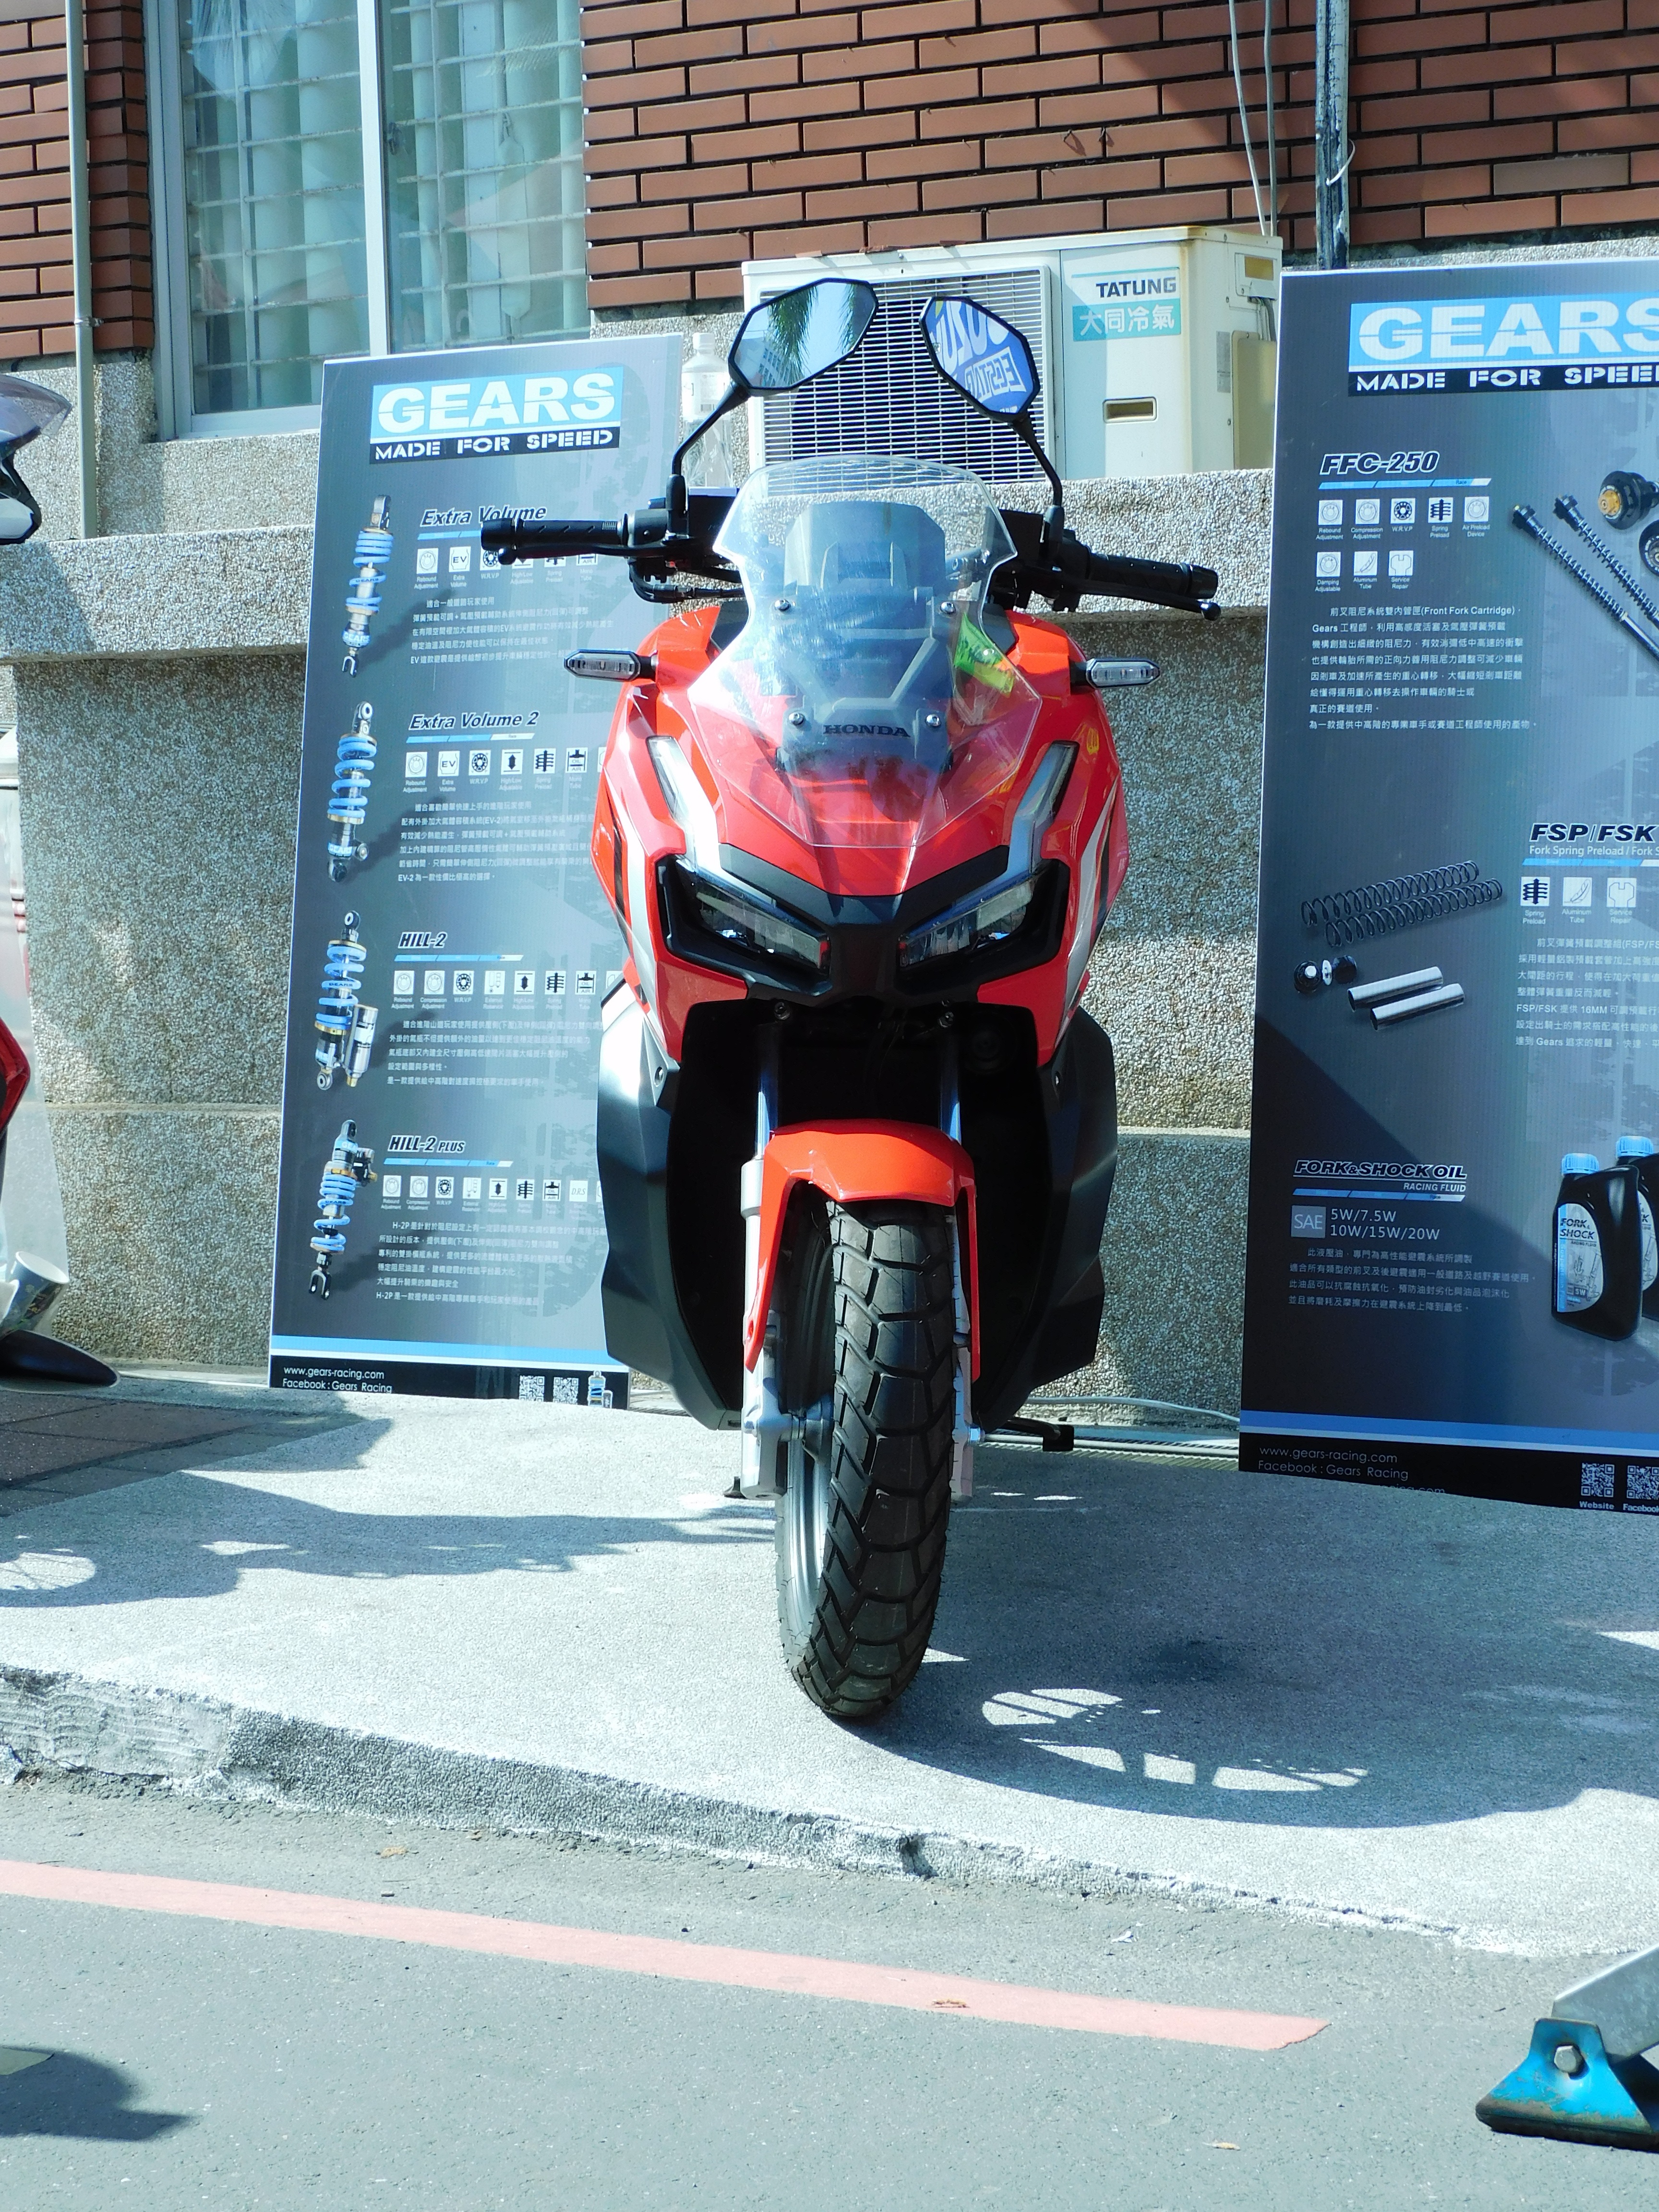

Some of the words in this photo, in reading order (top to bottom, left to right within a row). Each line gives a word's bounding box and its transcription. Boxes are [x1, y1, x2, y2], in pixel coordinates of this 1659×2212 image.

[1096, 276, 1177, 298] TATUNG
[1080, 304, 1175, 336] 大同冷氣
[1359, 298, 1659, 361] GEARS
[1357, 372, 1445, 391] MADE
[1469, 369, 1540, 386] FOR
[1564, 365, 1659, 384] SPEE
[378, 373, 615, 433] GEARS
[375, 441, 441, 460] MADE
[457, 437, 510, 454] FOR
[527, 430, 613, 449] SPEED
[1319, 450, 1440, 475] FFC-250
[420, 507, 472, 527] Extra
[479, 505, 547, 523] Volume
[1449, 606, 1468, 614] Fork
[1312, 624, 1338, 632] Gears
[344, 634, 370, 642] GEARS
[409, 714, 455, 730] Extra
[461, 711, 523, 728] Volume
[527, 710, 540, 726] 2
[823, 724, 910, 738] HONDA
[1529, 822, 1659, 843] FSP/FSK
[1529, 846, 1551, 854] Fork
[1553, 846, 1584, 857] Spring
[1587, 846, 1624, 855] Preload
[1632, 846, 1653, 855] Fork
[398, 932, 447, 949] HILL-2
[1516, 1004, 1557, 1013] FSP/FSK
[1560, 1005, 1578, 1013] 提供
[1581, 1006, 1607, 1014] 16MM
[1536, 1037, 1563, 1046] Gears
[387, 1135, 437, 1153] HILL-2
[437, 1140, 466, 1153] PLUS
[1433, 1164, 1467, 1179] OIL
[1403, 1183, 1438, 1191] RACING
[1440, 1184, 1466, 1192] FLUID
[1294, 1214, 1322, 1230] SAE
[1331, 1208, 1396, 1222] 5W/7.5W
[1560, 1218, 1587, 1227] FORK
[1330, 1225, 1440, 1240] 10W/15W/20W
[1560, 1229, 1595, 1239] SHOCK
[284, 1367, 384, 1380] www.gears-racing.com
[332, 1381, 357, 1391] Gears
[361, 1382, 392, 1394] Racing
[1260, 1447, 1397, 1464] www.gears-racing.com
[1326, 1464, 1361, 1476] Gears
[1367, 1467, 1408, 1481] Racing
[1579, 1501, 1614, 1510] Website
